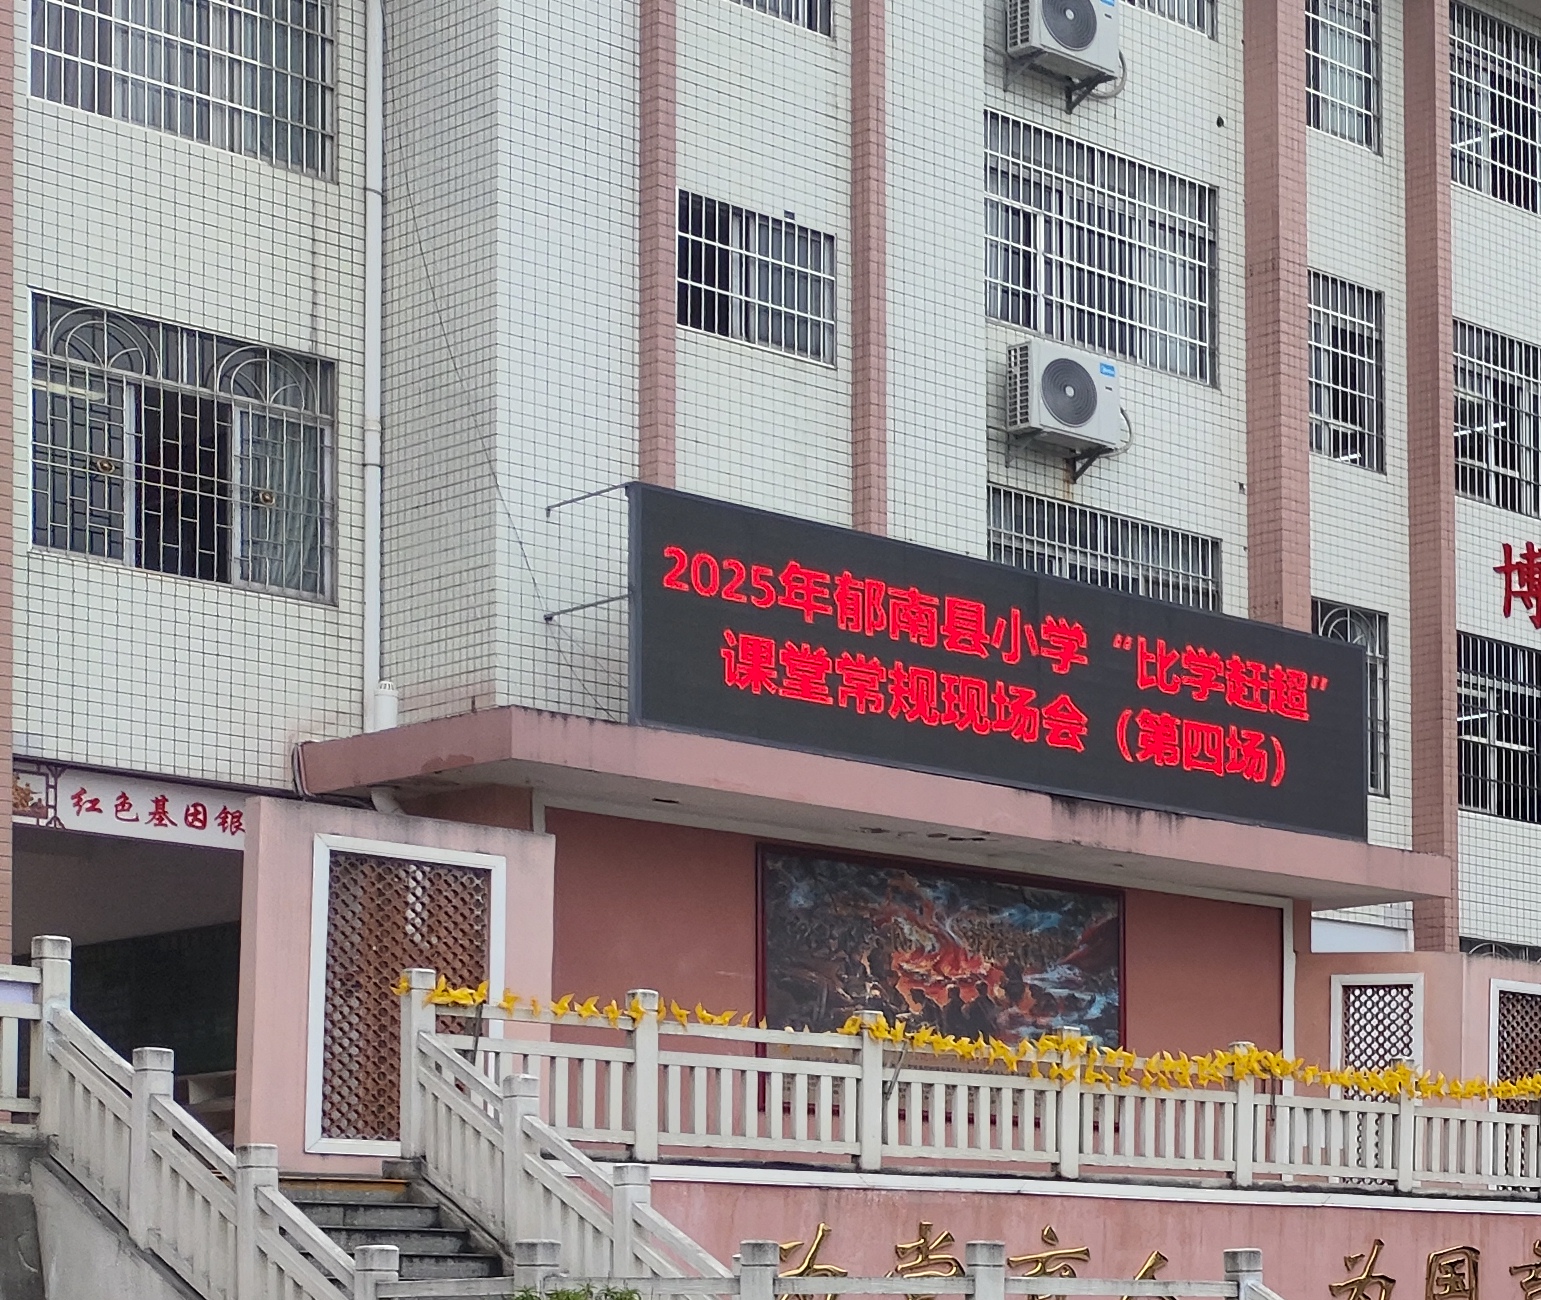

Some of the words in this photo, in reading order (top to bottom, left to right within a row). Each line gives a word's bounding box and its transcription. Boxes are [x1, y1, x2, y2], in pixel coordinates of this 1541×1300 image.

[70, 786, 246, 836] 红色基因银
